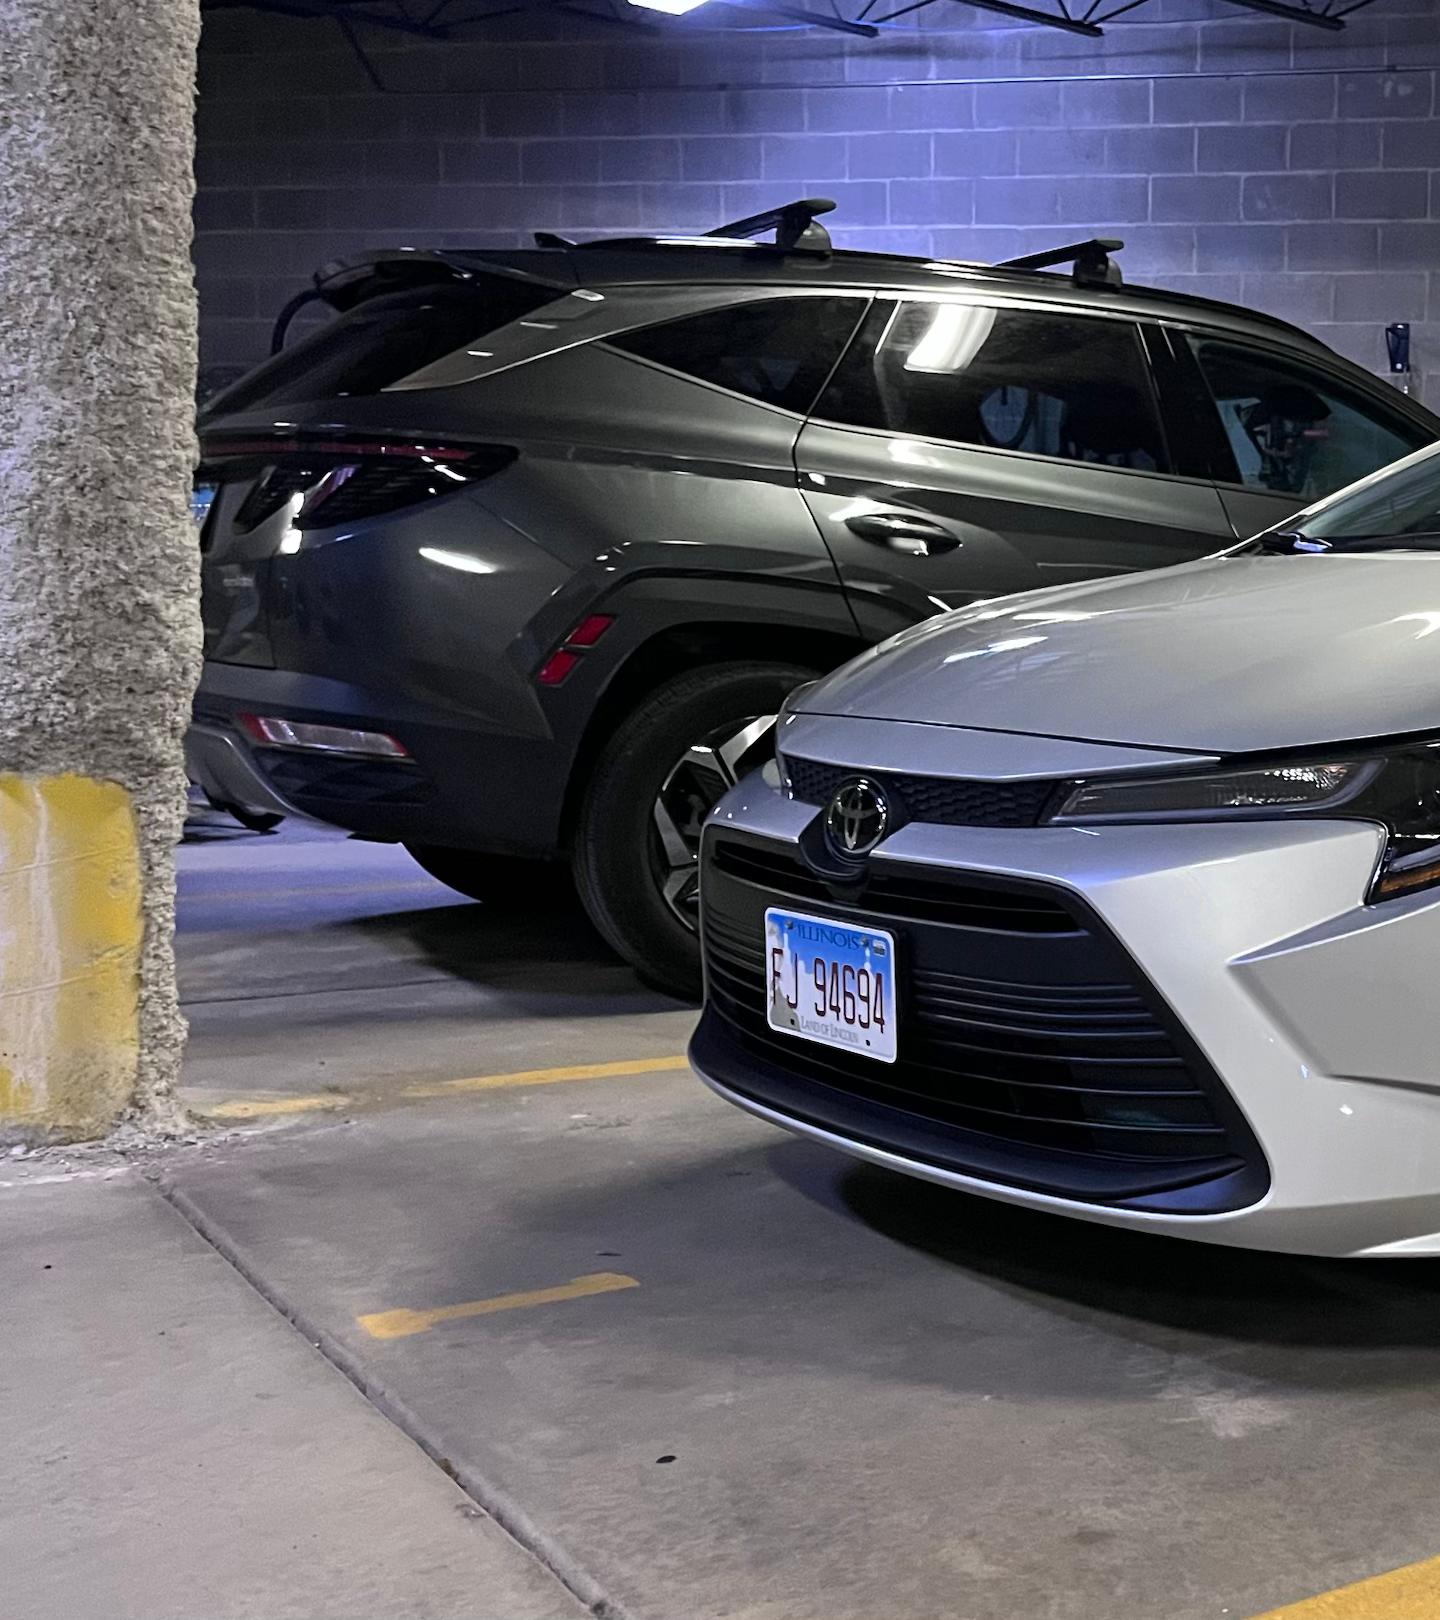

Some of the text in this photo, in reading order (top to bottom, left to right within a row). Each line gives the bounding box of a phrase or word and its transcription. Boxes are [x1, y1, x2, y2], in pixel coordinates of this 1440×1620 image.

[798, 923, 860, 950] ILLINOIS
[772, 947, 885, 1034] FJ 94694
